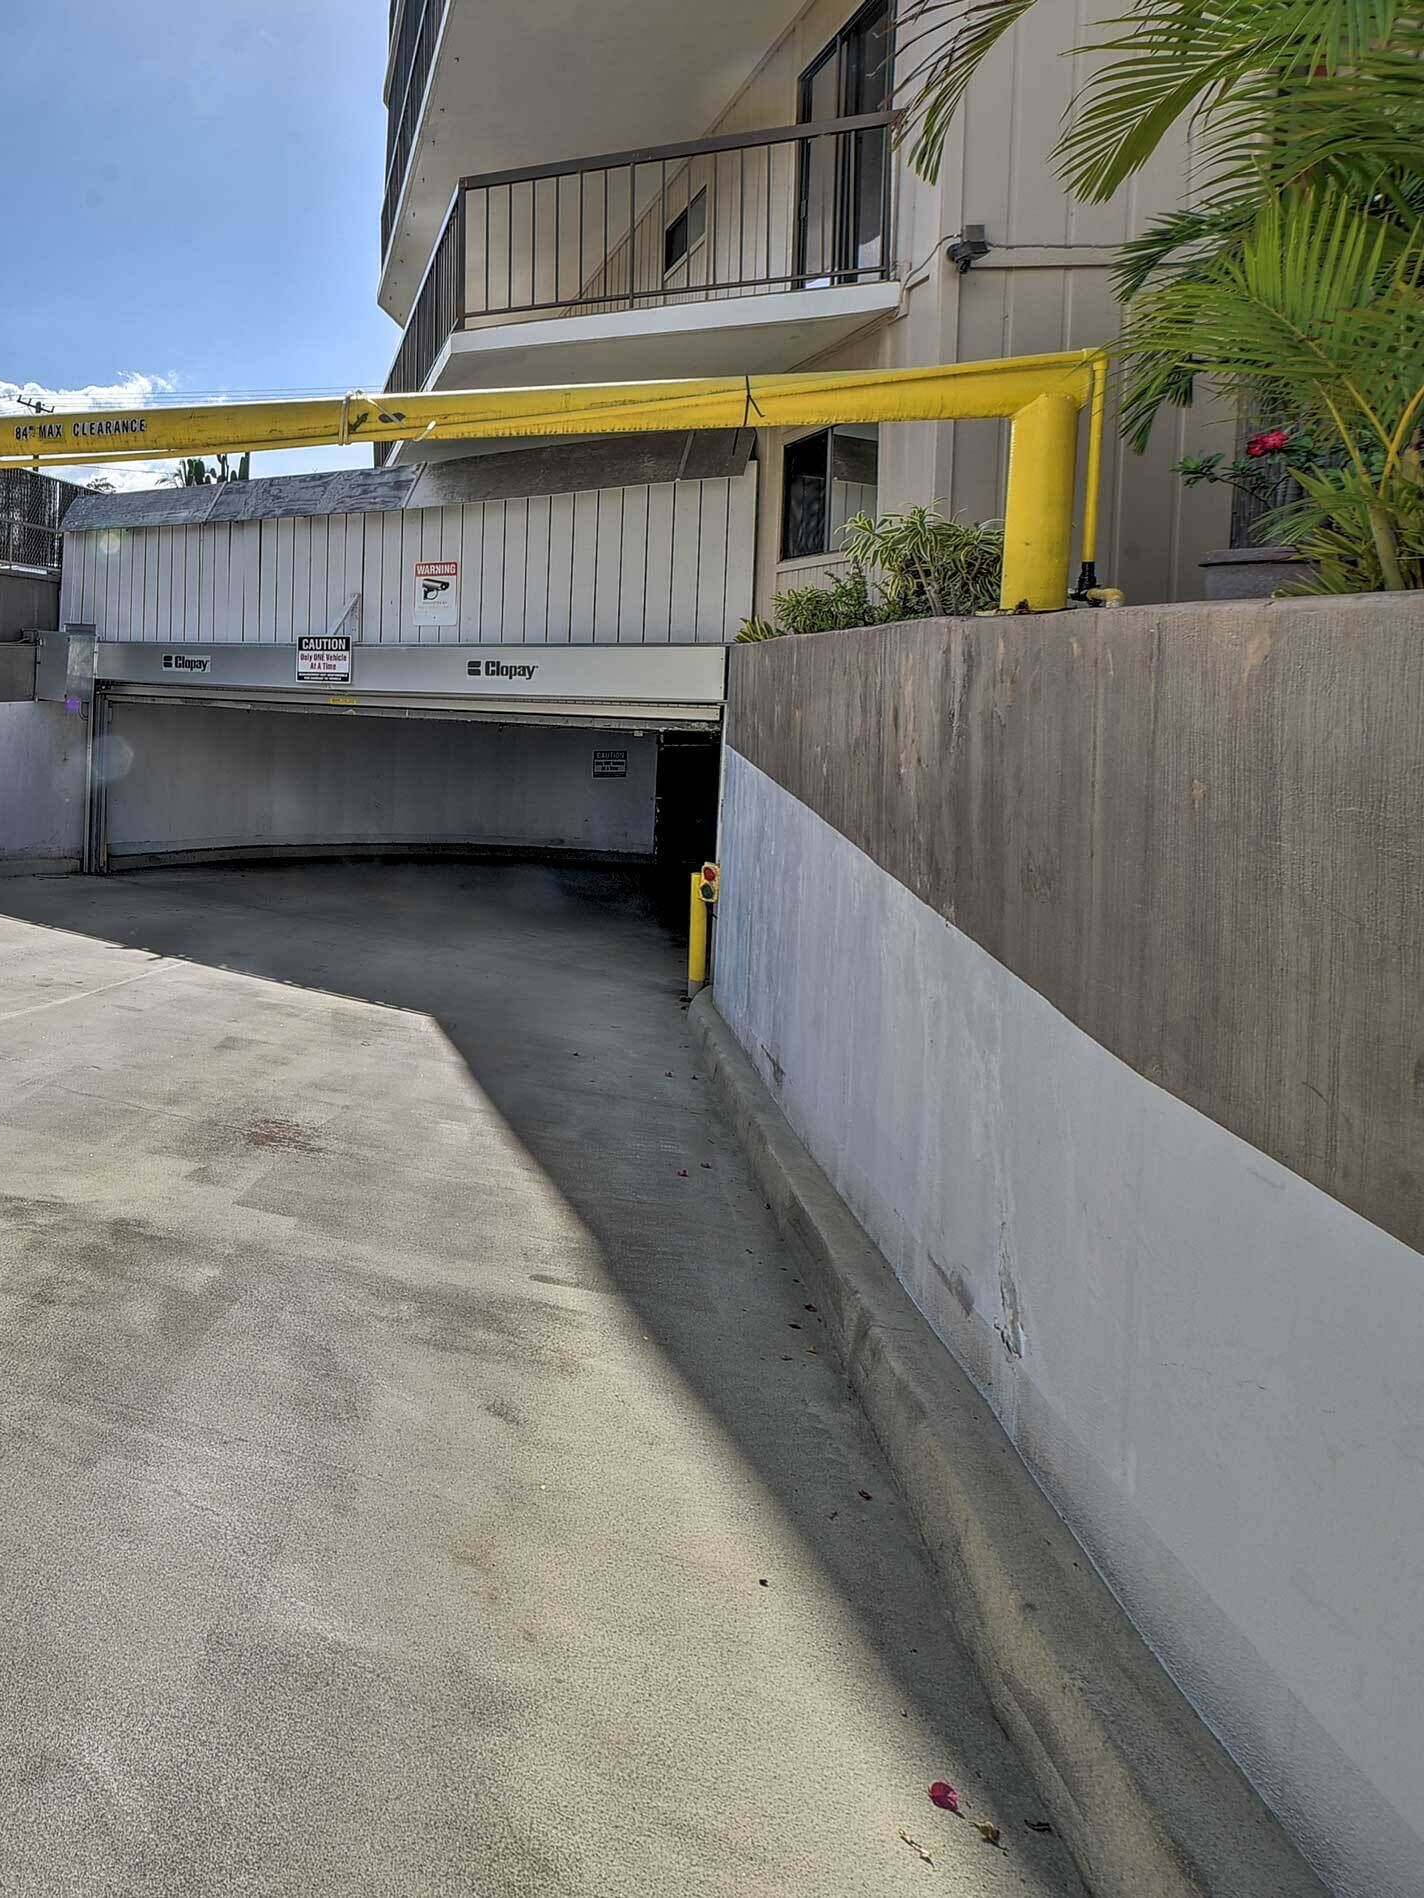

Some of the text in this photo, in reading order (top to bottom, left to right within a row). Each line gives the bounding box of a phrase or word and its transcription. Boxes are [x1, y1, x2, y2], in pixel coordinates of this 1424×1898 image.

[39, 424, 62, 438] MAX
[73, 418, 146, 436] CLEARANCE
[417, 564, 456, 574] WARNING
[302, 638, 346, 650] CAUTION
[301, 653, 347, 661] Only ONE Vehicle
[175, 656, 208, 671] Clopay
[310, 662, 317, 670] At
[323, 662, 336, 670] Time
[485, 661, 535, 680] Clopay
